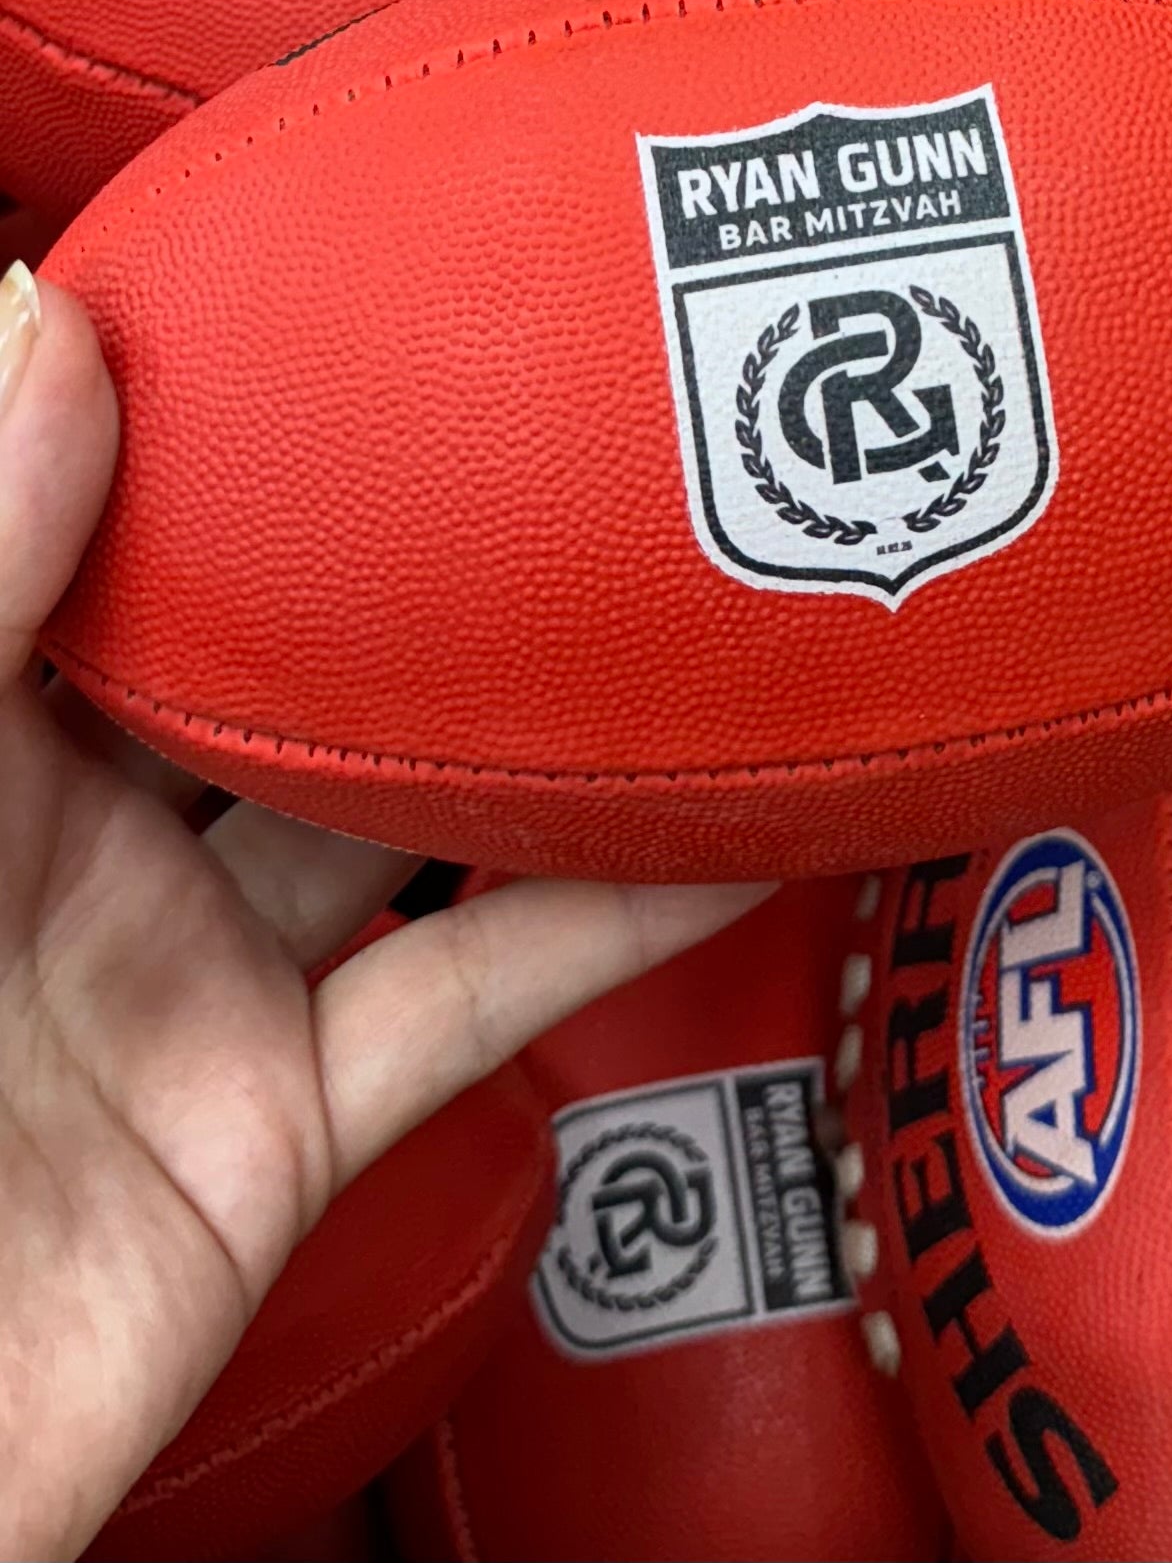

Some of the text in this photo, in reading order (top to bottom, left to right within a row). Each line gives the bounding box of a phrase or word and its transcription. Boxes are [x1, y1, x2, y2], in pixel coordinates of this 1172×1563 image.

[677, 126, 989, 221] RYAN GUNN
[718, 189, 963, 251] BAR MITZVAH
[1001, 859, 1097, 1185] AFL
[761, 1082, 834, 1300] RYAN GUNN
